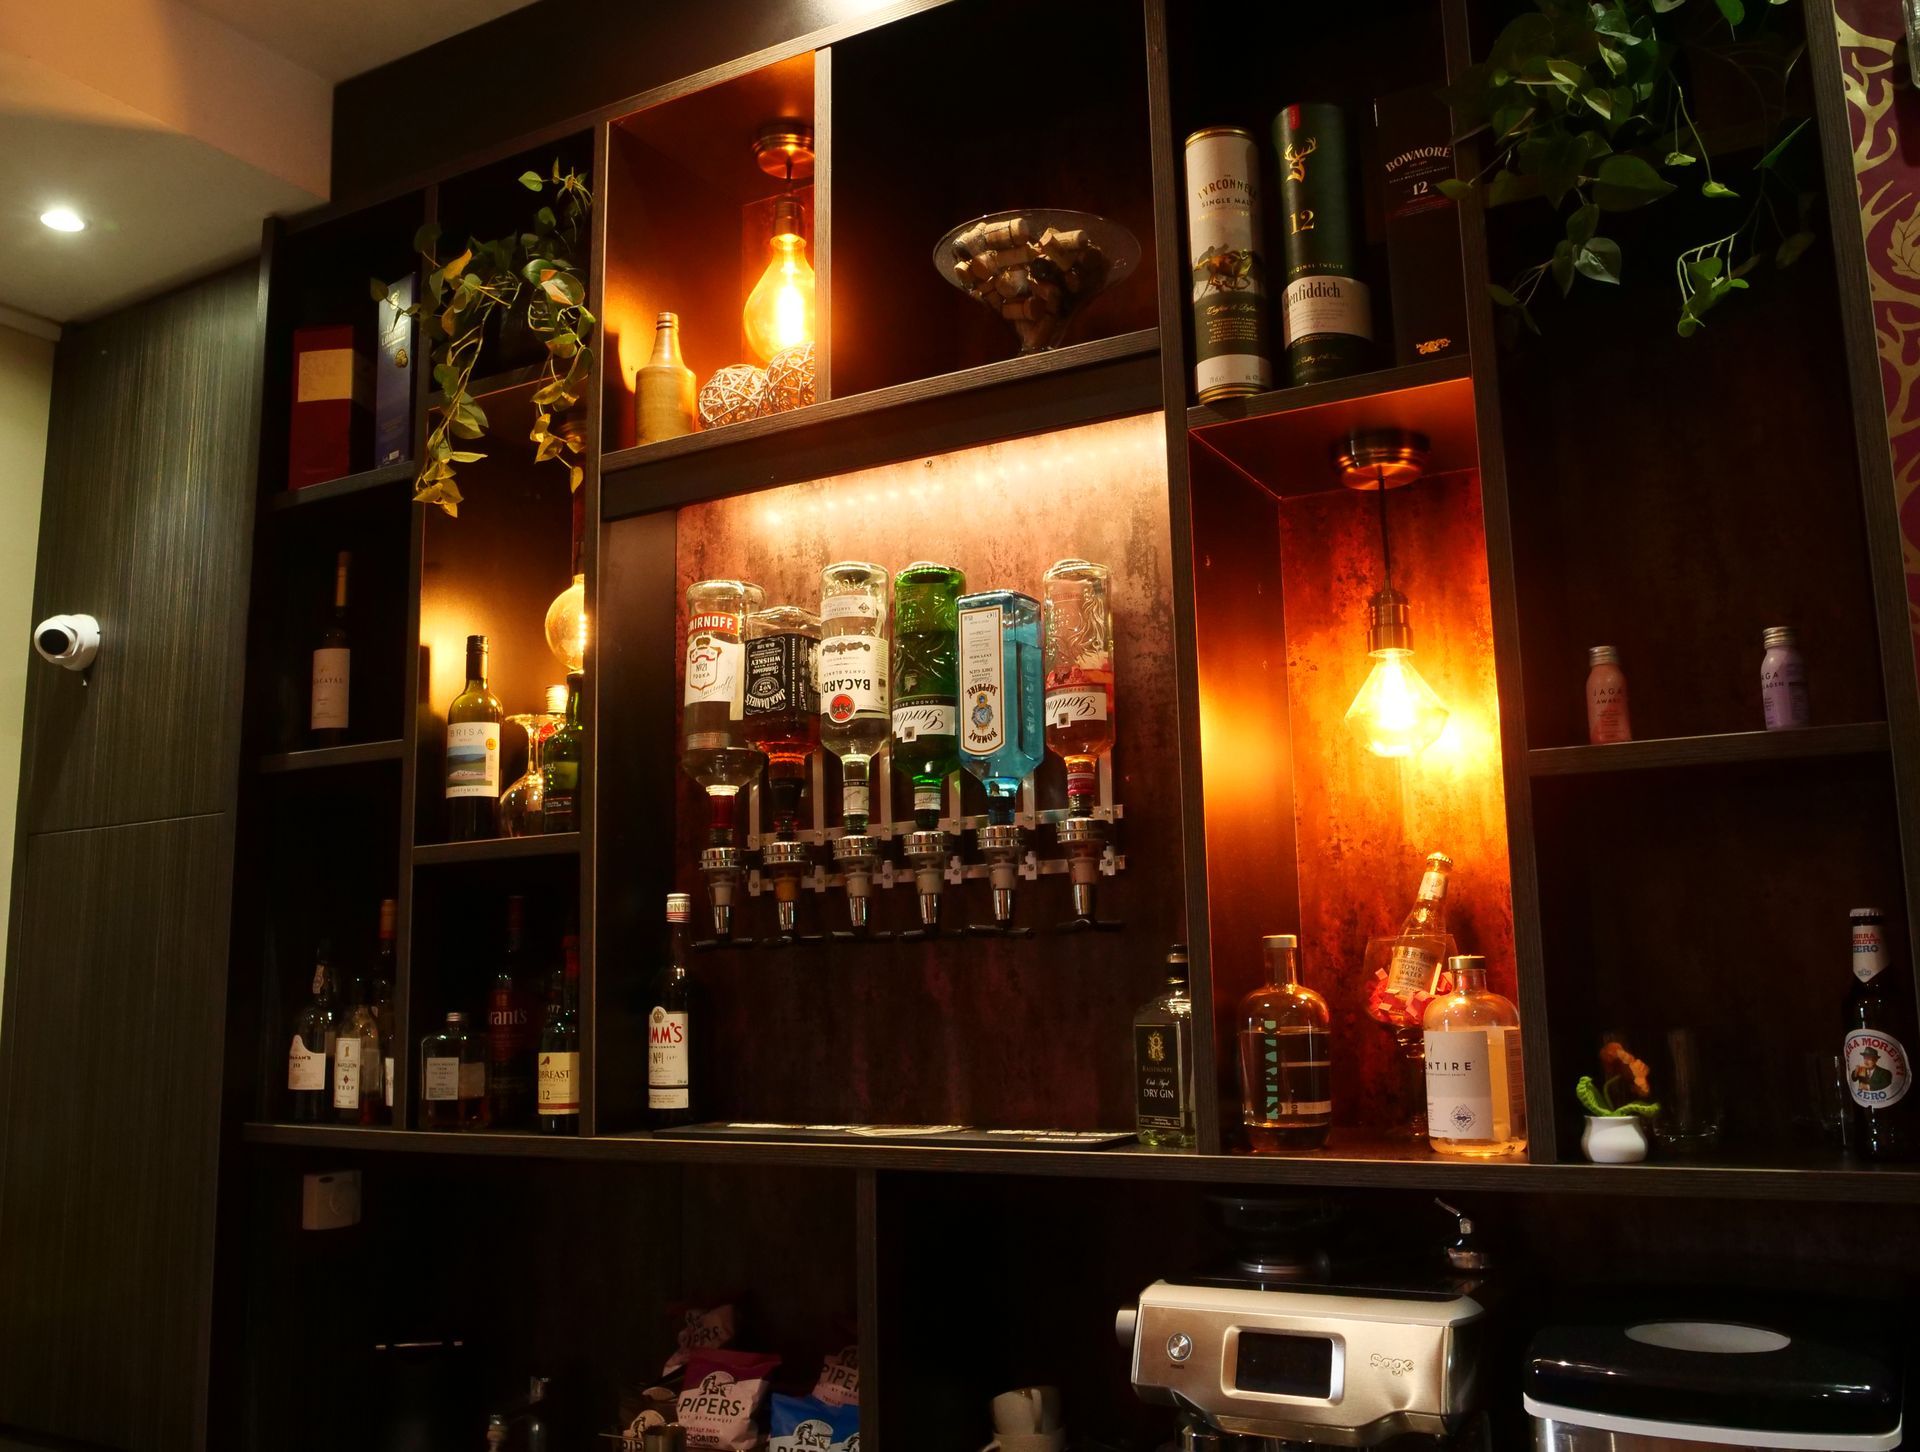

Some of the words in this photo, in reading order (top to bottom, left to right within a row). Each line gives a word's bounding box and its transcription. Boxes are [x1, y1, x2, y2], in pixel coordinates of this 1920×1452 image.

[1385, 146, 1451, 173] BOWMORE
[1413, 181, 1428, 195] 12
[1202, 198, 1231, 208] SINGLE
[1290, 210, 1314, 235] 12
[688, 615, 733, 632] MIRNOFF
[751, 655, 781, 666] WHISKEY
[769, 688, 786, 705] JACK
[966, 683, 998, 699] SAPPHIRE
[450, 728, 484, 738] BRISA
[969, 728, 998, 744] BOMBAY
[542, 1090, 550, 1100] 12
[1143, 1088, 1158, 1098] DRY
[1159, 1089, 1174, 1099] GIN
[1857, 1090, 1887, 1101] ZERO
[1370, 1353, 1415, 1377] Sage
[680, 1398, 742, 1416] PIPERS
